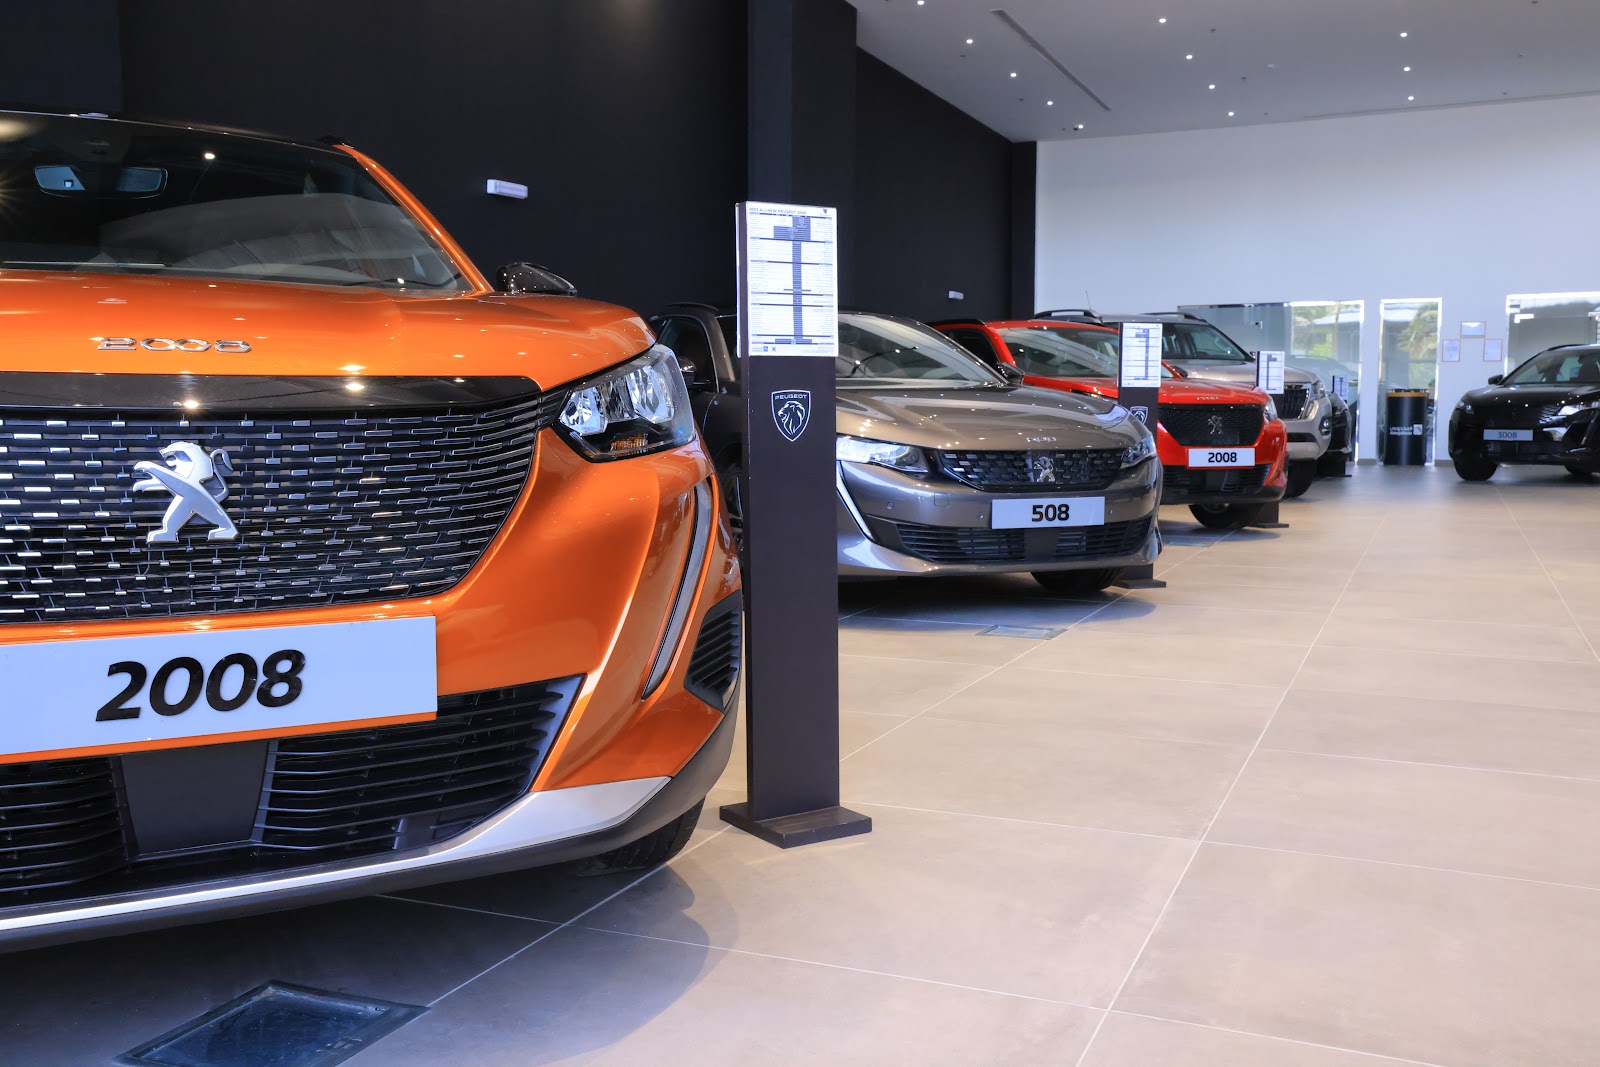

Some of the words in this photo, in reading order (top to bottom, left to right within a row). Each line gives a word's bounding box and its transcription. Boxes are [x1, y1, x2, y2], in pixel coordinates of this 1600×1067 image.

[97, 337, 253, 353] 2008
[1498, 431, 1518, 439] 3008
[1208, 452, 1237, 463] 2008
[1031, 504, 1070, 522] 508
[95, 649, 306, 722] 2008
